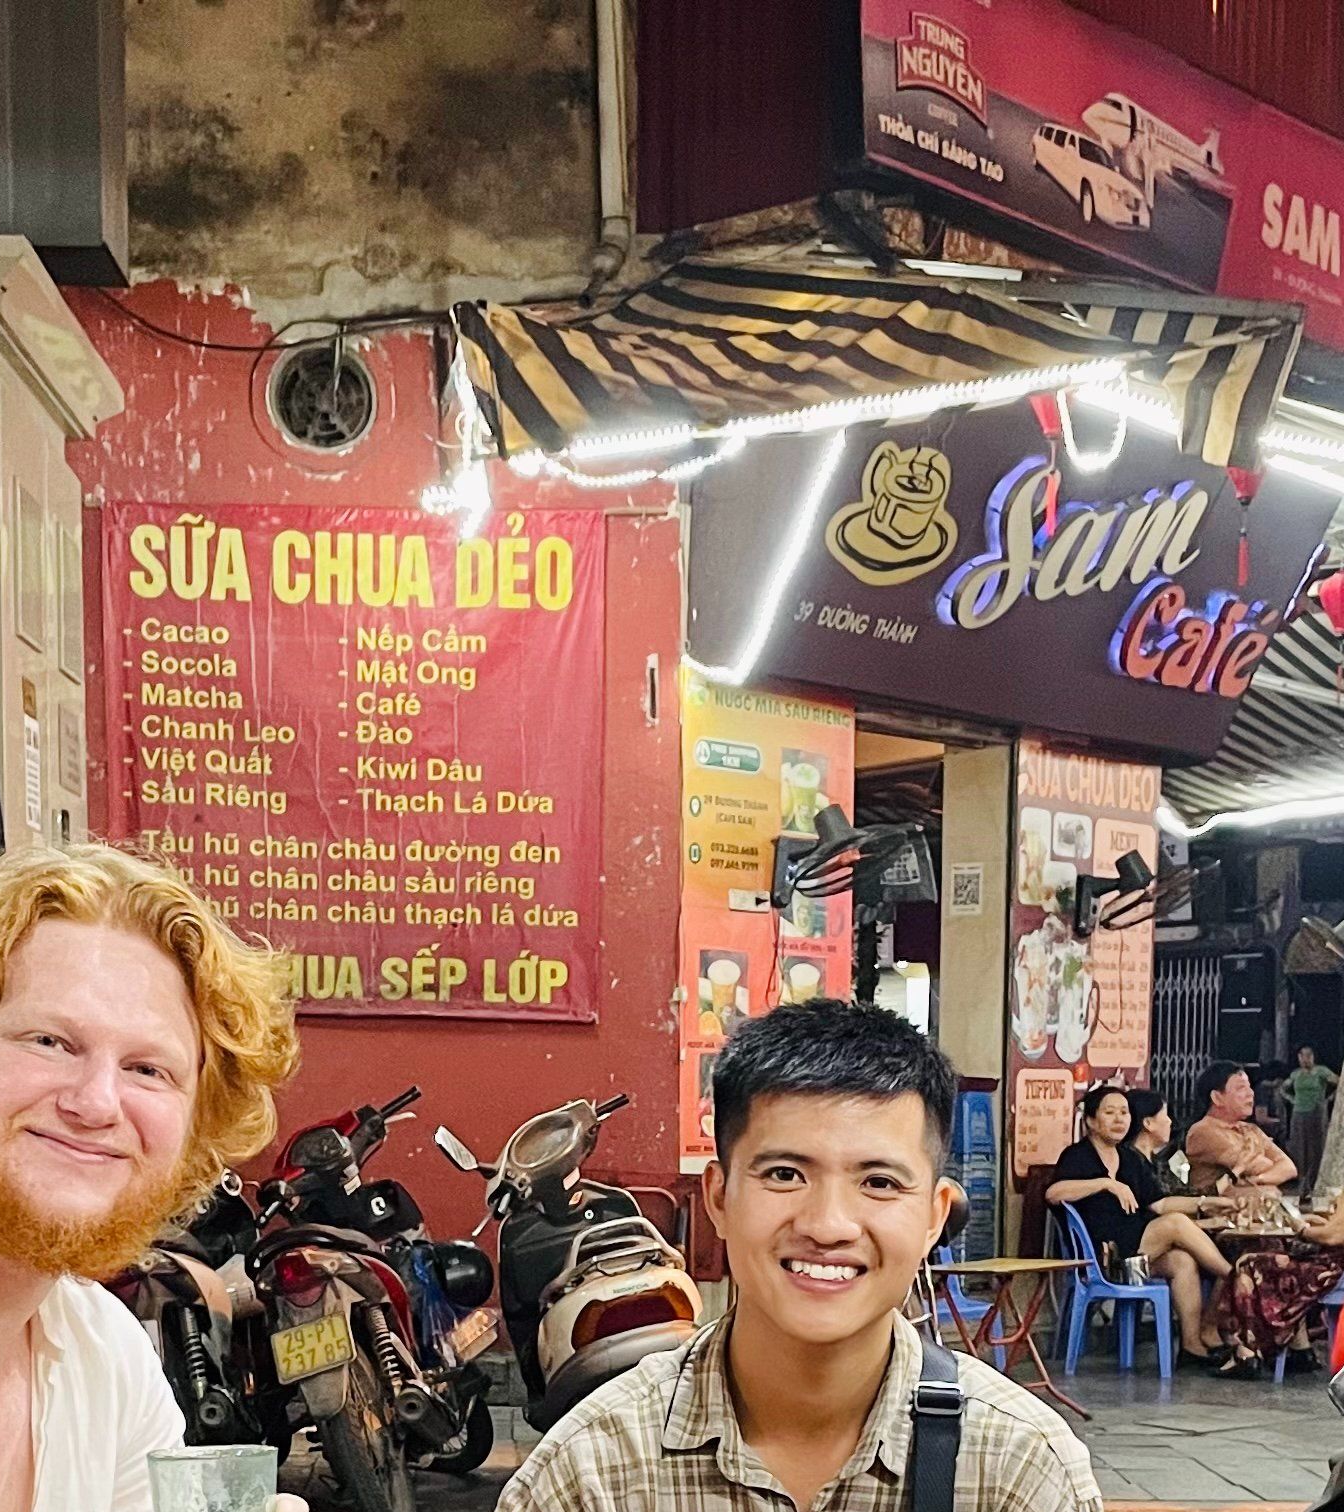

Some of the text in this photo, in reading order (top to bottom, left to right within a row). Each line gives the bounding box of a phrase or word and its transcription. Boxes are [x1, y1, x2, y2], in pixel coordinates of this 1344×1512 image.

[918, 19, 965, 60] TRUNG
[1261, 182, 1341, 278] SAM
[129, 512, 575, 611] SỮA CHUA DẺO
[958, 466, 1208, 630] Sam
[794, 601, 815, 622] 39
[140, 617, 230, 644] Cacao
[357, 623, 414, 657] Nếp
[141, 650, 237, 677] Socola
[357, 659, 408, 688] Mật
[141, 682, 243, 709] Matcha
[356, 692, 422, 716] Café
[141, 714, 295, 744] Chanh Leo
[356, 720, 413, 745] Đào
[141, 745, 273, 776] Việt Quất
[357, 756, 482, 782] Kiwi Dâu
[205, 782, 287, 815] Riêng
[356, 788, 554, 818] Thạch Lá Dứa
[205, 831, 240, 856] hũ
[249, 834, 318, 859] chân
[327, 836, 396, 861] châu
[405, 839, 501, 868] đường
[509, 840, 561, 864] đen
[205, 863, 240, 887] hũ
[249, 866, 318, 891] chân
[327, 869, 396, 893] châu
[464, 871, 535, 900] riêng
[249, 897, 318, 921] chân
[327, 900, 396, 924] châu
[405, 902, 482, 930] thạch
[492, 902, 514, 925] lá
[524, 903, 579, 927] dứa
[379, 943, 467, 1002] SẾP
[483, 949, 568, 1004] LỚP
